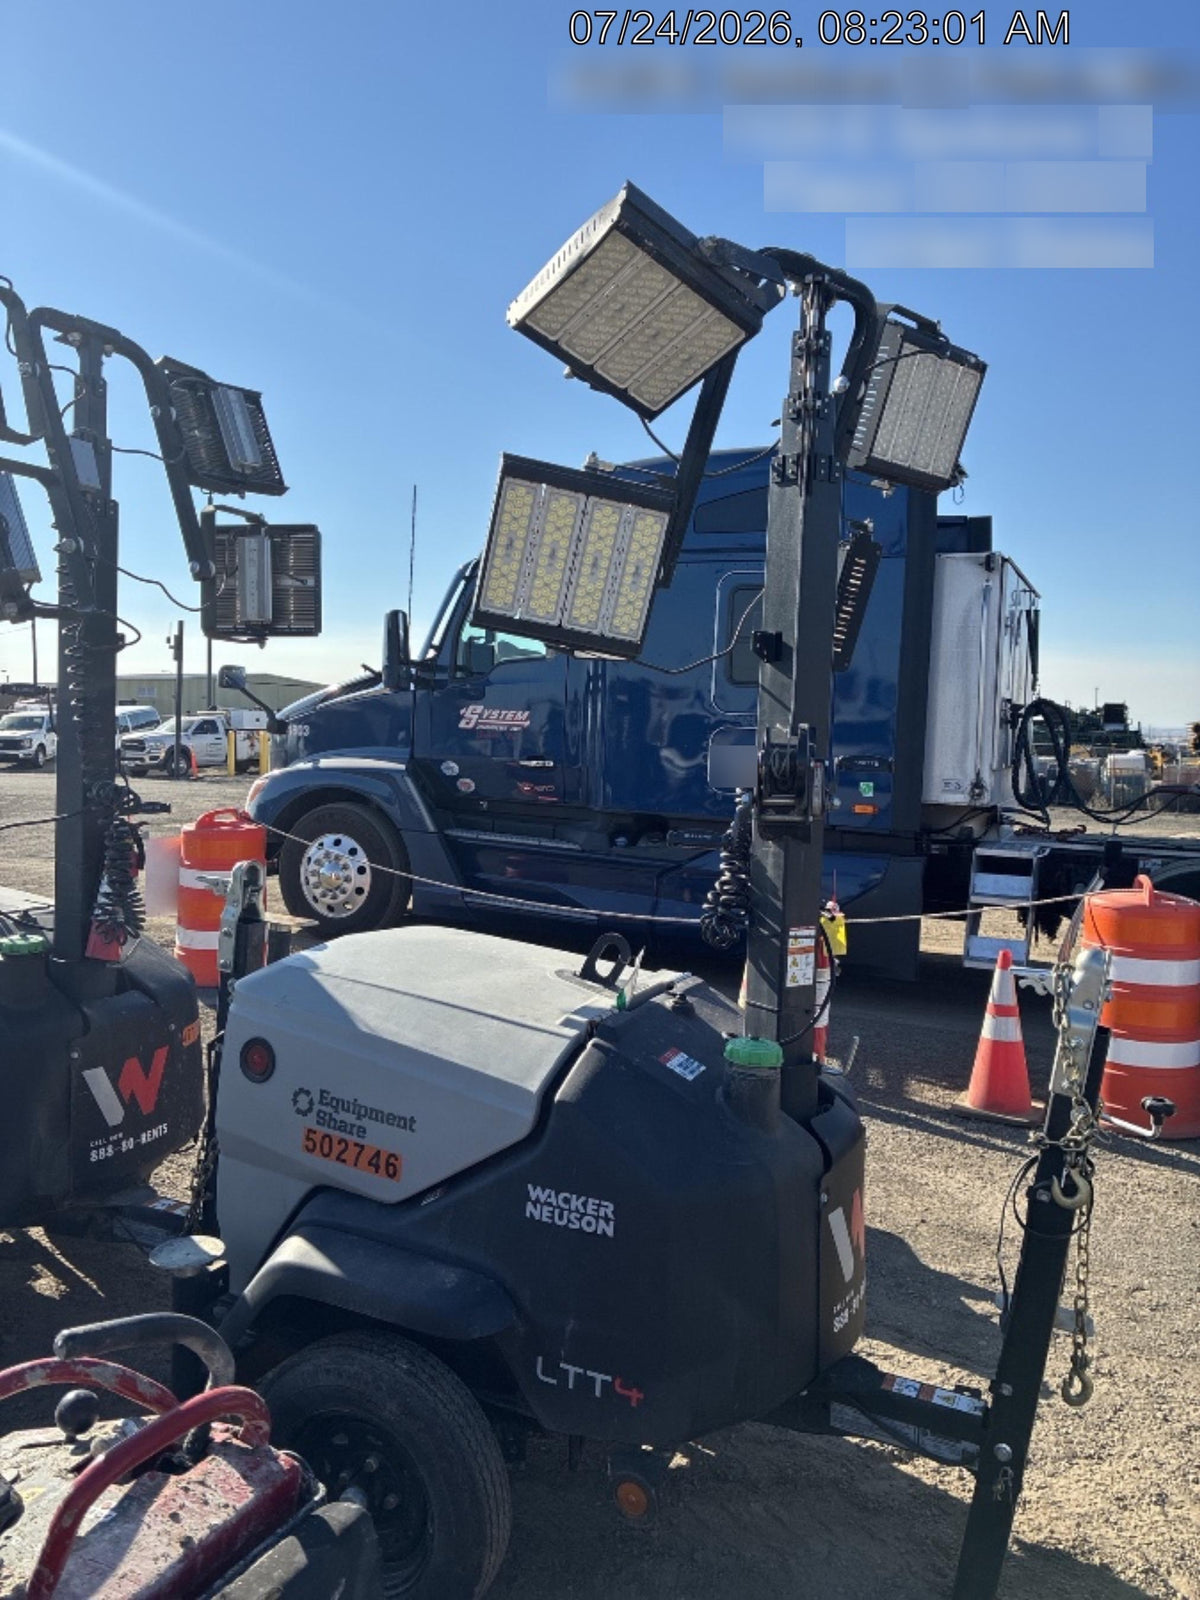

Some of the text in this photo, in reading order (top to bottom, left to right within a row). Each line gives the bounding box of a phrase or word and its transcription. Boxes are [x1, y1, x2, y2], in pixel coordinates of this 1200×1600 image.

[315, 1109, 368, 1139] Share
[318, 1088, 417, 1133] Equipment
[304, 1128, 399, 1179] 502746
[525, 1201, 615, 1238] NEUSON
[527, 1183, 615, 1219] WACKER
[536, 1356, 644, 1407] LTT4
